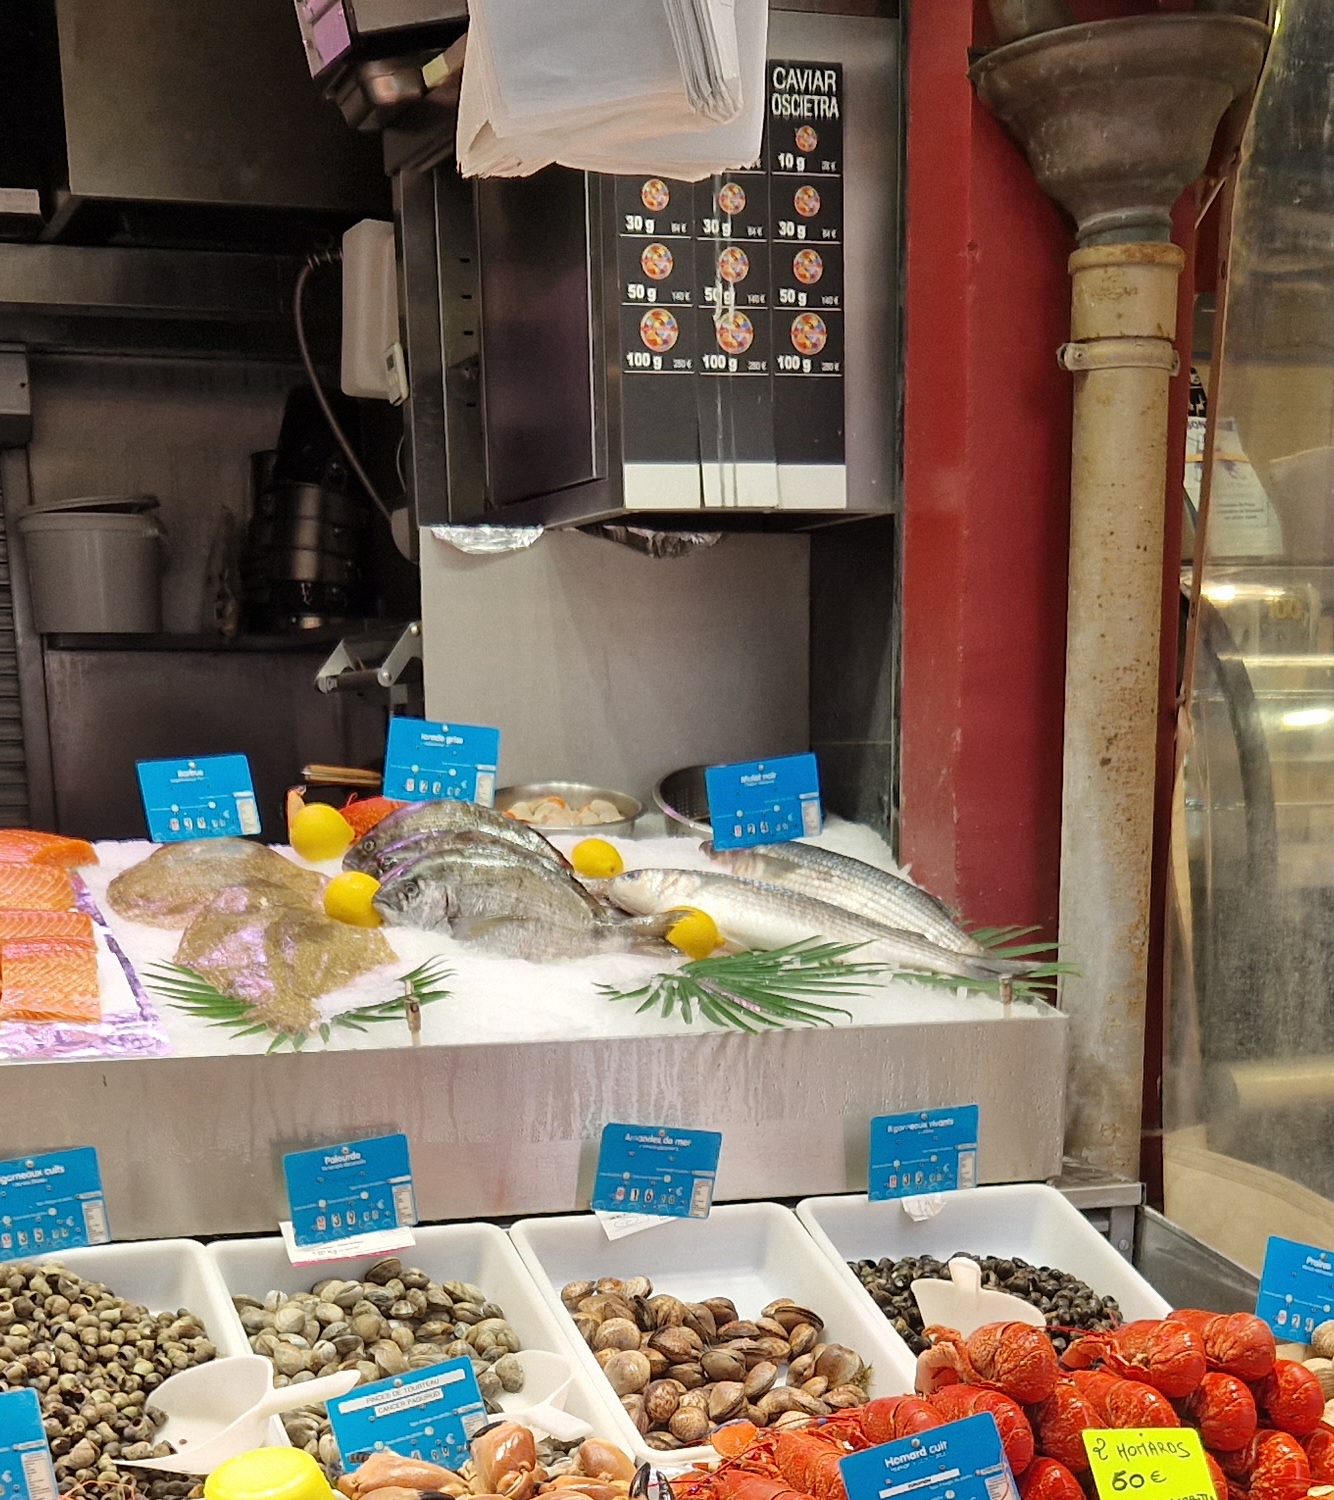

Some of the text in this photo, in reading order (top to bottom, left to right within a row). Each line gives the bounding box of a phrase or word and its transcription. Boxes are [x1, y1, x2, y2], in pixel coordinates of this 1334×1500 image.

[772, 66, 837, 92] CAVIAR
[771, 93, 840, 119] OSCIETRA
[778, 152, 793, 168] 10
[796, 156, 806, 172] g
[625, 215, 643, 230] 30
[645, 218, 655, 233] g
[702, 218, 720, 233] 30
[722, 222, 732, 237] g
[778, 221, 795, 235] 30
[797, 224, 806, 239] g
[627, 284, 645, 298] 50
[646, 287, 657, 302] g
[723, 290, 735, 304] g
[779, 289, 796, 303] 50
[798, 292, 807, 306] g
[626, 352, 650, 367] 100
[653, 355, 663, 370] g
[703, 354, 726, 369] 100
[728, 357, 738, 372] g
[778, 355, 801, 370] 100
[803, 358, 811, 373] g
[324, 1151, 362, 1166] Palourde
[885, 1447, 928, 1469] Homard
[929, 1440, 948, 1454] cuit
[1117, 1441, 1191, 1462] HOMARDS
